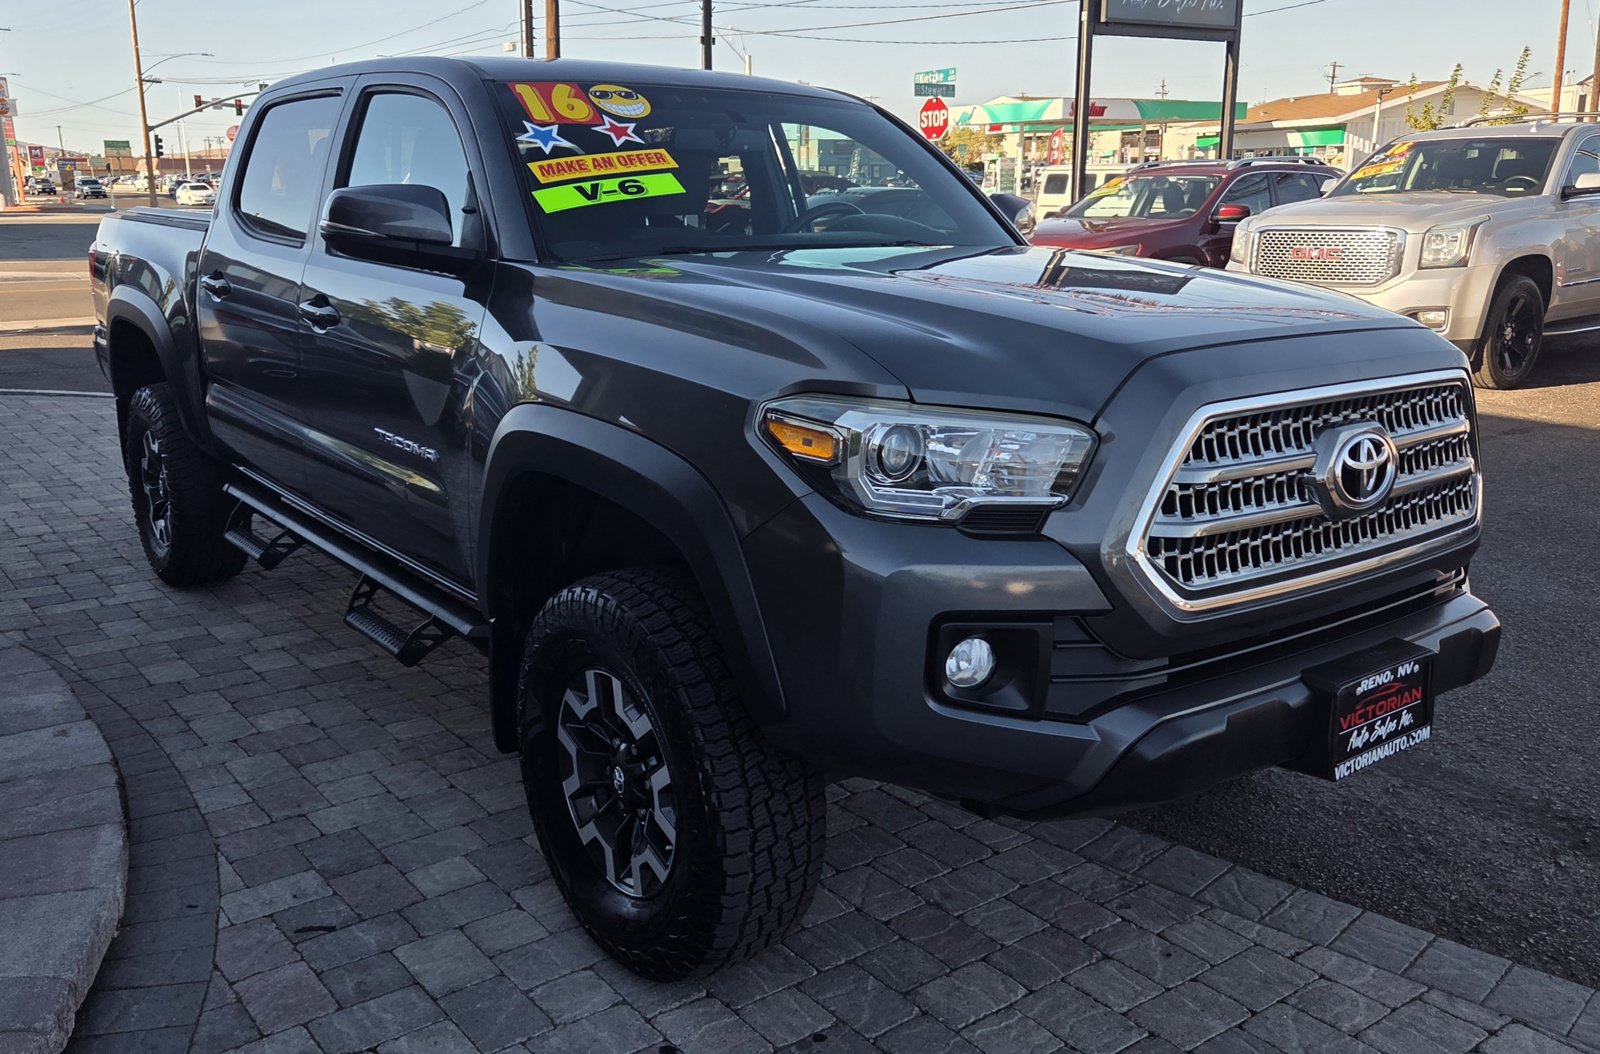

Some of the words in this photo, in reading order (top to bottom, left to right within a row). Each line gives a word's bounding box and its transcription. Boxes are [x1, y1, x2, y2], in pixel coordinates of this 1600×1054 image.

[515, 84, 593, 121] 16
[920, 85, 947, 96] Stewart
[920, 109, 947, 128] STOP
[538, 162, 588, 178] MAKE
[592, 157, 617, 170] AN
[619, 152, 669, 167] OFFER
[573, 179, 649, 202] V-6
[1292, 247, 1343, 260] GMC
[1359, 671, 1394, 693] RENO,
[1340, 687, 1423, 730] VICTORIAN
[1346, 726, 1369, 752] Auto
[1370, 716, 1397, 742] Sales
[1397, 709, 1414, 730] Inc.
[1334, 726, 1431, 780] VICTORIANAUTO.COM
